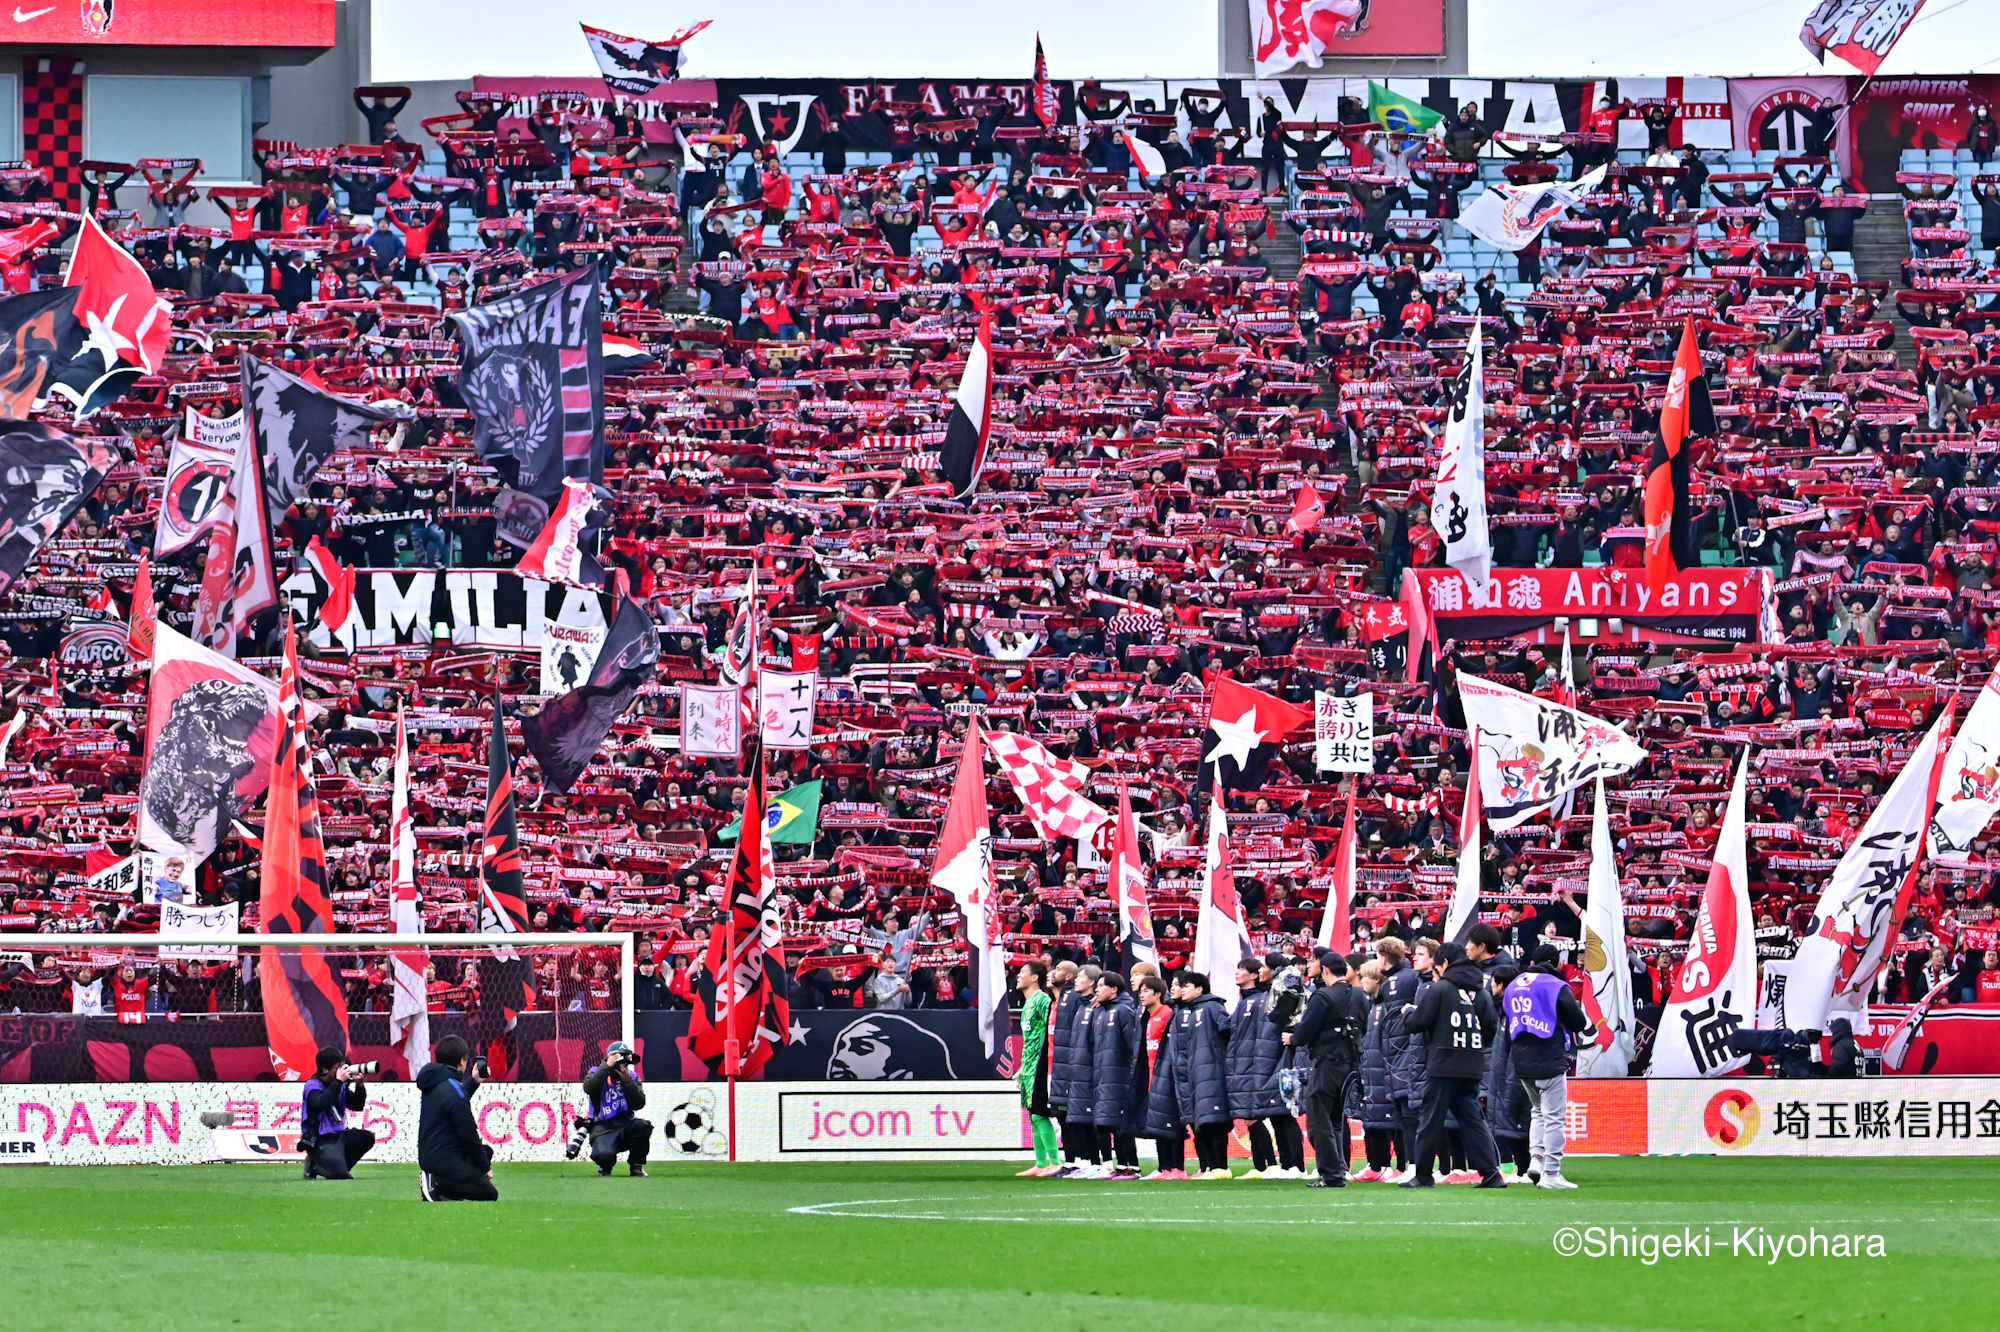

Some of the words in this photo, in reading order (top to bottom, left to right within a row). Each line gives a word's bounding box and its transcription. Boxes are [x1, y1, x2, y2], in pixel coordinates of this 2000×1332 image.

[1868, 79, 1968, 97] SUPPORTERS
[1676, 104, 1722, 118] BLAZE
[1902, 103, 1955, 120] SPIRIT
[1314, 264, 1337, 274] URAWA
[1338, 264, 1356, 273] REDS
[1237, 312, 1256, 322] PRIDE
[1257, 312, 1265, 321] OF
[1265, 310, 1290, 320] URAWA
[193, 425, 241, 441] Everyone
[58, 538, 84, 549] PRIDE
[85, 538, 96, 548] OF
[103, 564, 180, 579] GARONS
[1772, 577, 1805, 593] URAWA
[1807, 572, 1831, 585] REDS
[280, 571, 609, 650] FMILIA
[550, 626, 589, 644] URAWA
[1703, 628, 1726, 638] SINCE
[1728, 627, 1747, 639] 1994
[65, 708, 90, 719] PRIDE
[92, 709, 103, 719] OF
[764, 693, 785, 731] 一色
[788, 679, 809, 738] 十一人
[1319, 697, 1358, 717] 赤き
[828, 733, 839, 743] OF
[840, 731, 871, 742] URAWA
[1318, 721, 1370, 742] 誇りと
[1330, 743, 1370, 763] 共に
[1669, 852, 1696, 864] URAWA
[564, 867, 597, 878] URAWA
[597, 869, 616, 879] REDS
[165, 906, 234, 927] 勝つしか
[1649, 905, 1676, 918] REDS
[1698, 890, 1718, 955] RAWA
[121, 992, 140, 1001] POLUS
[1878, 1024, 1924, 1037] URA
[17, 1101, 181, 1145] DAZN
[808, 1101, 928, 1140] jcom
[930, 1104, 976, 1136] tv
